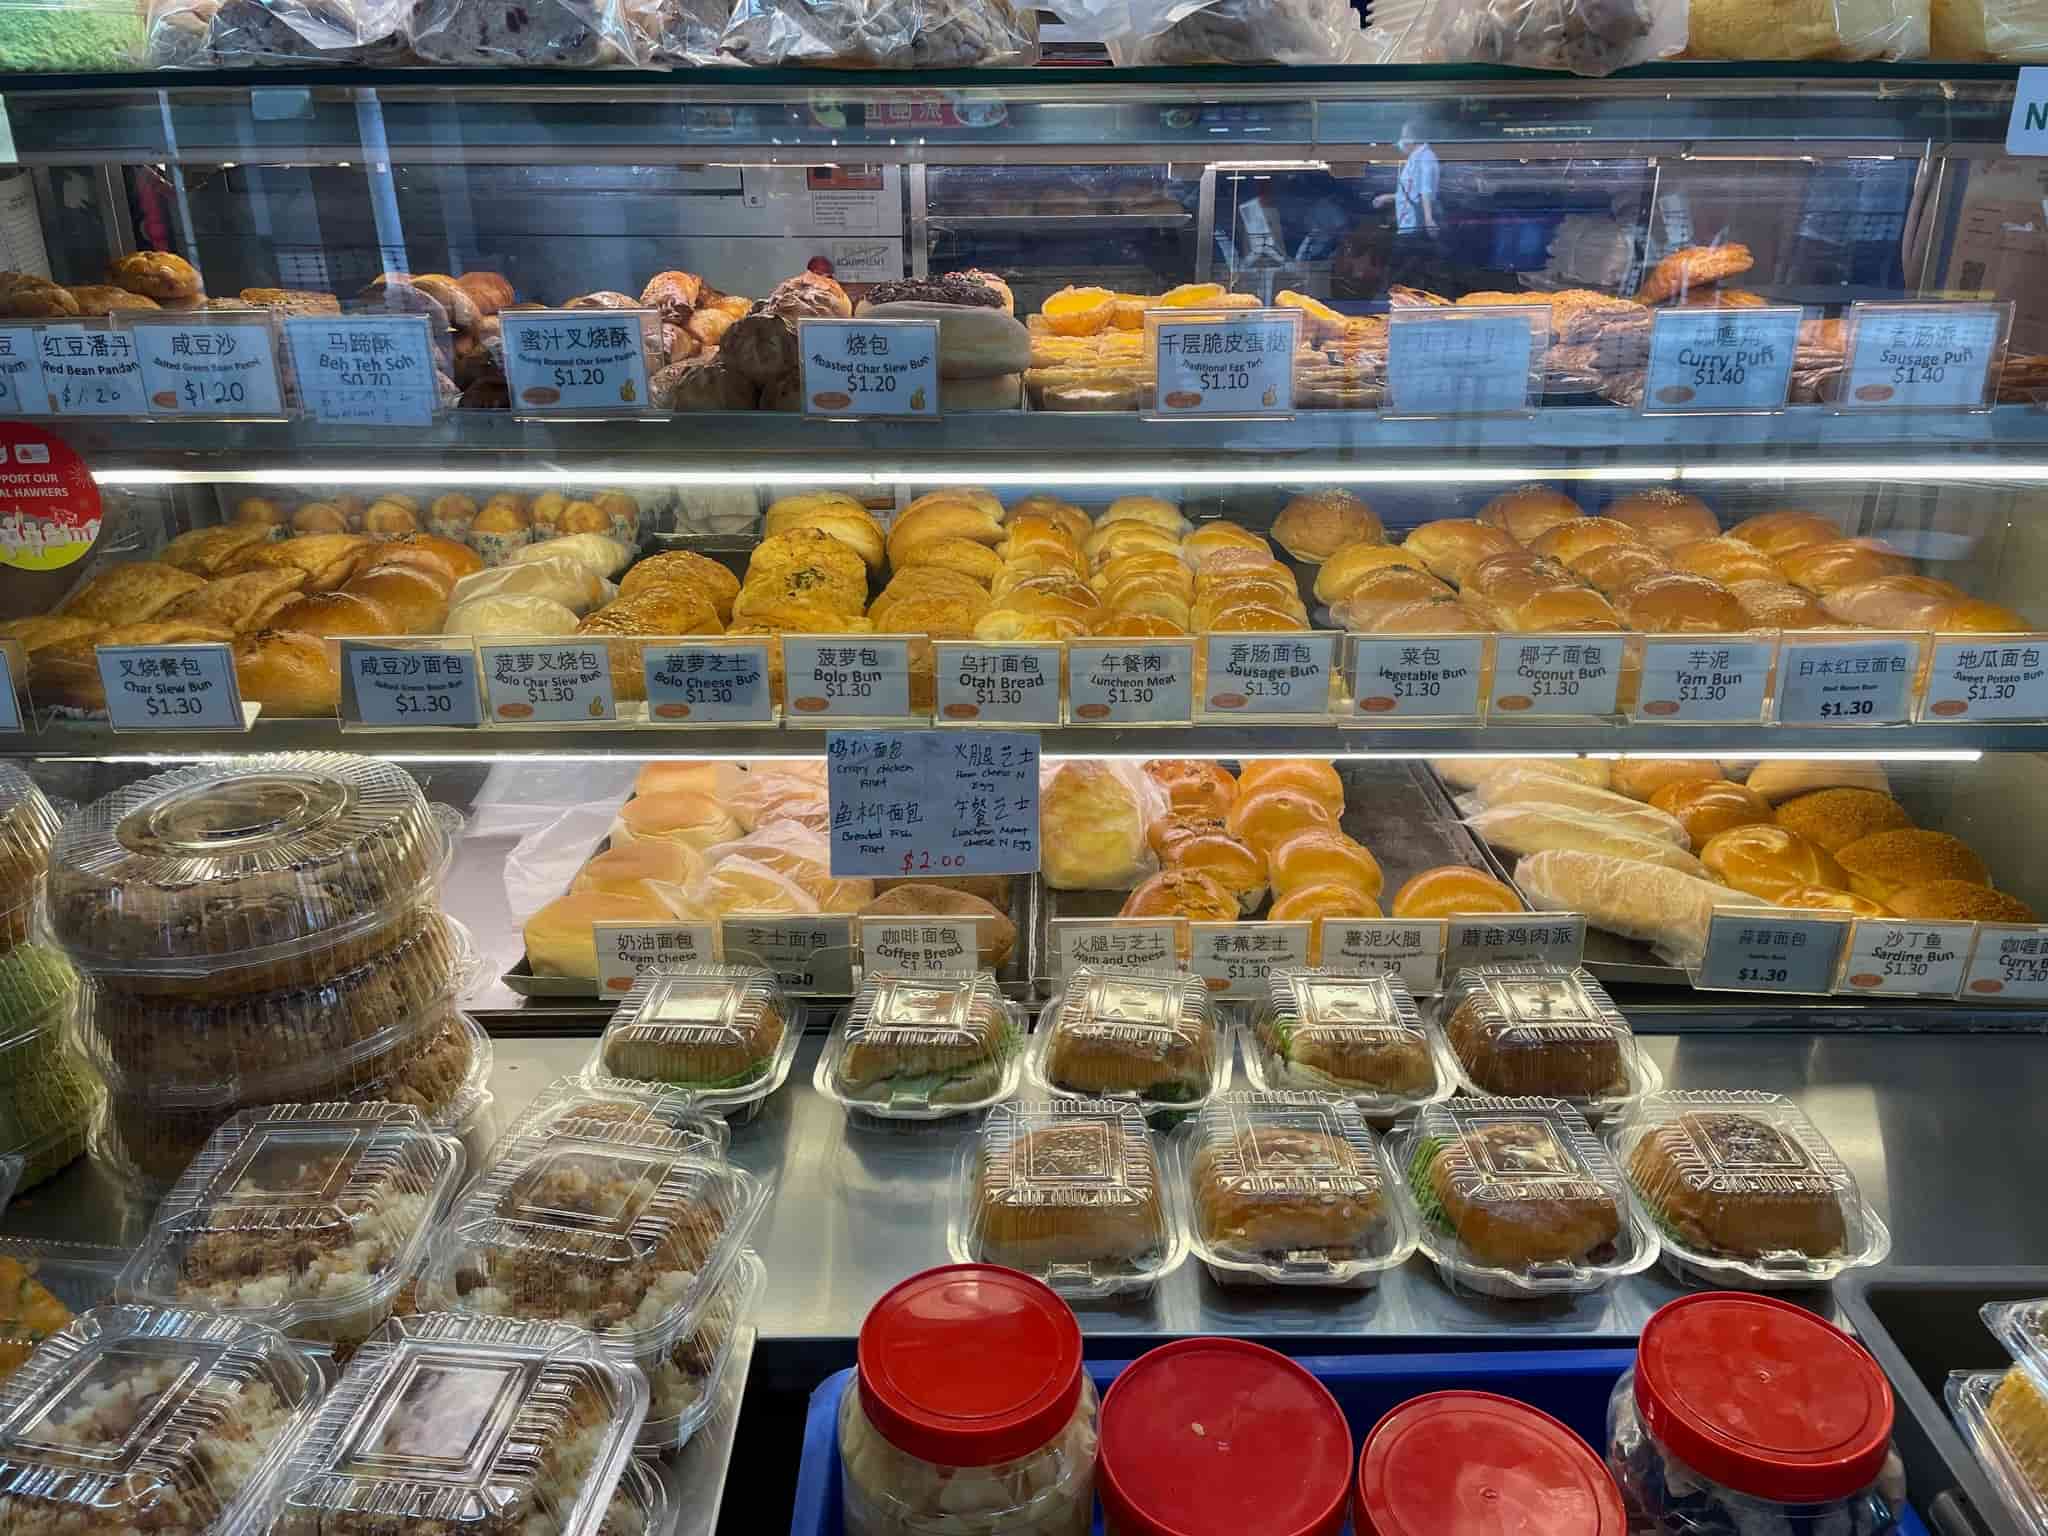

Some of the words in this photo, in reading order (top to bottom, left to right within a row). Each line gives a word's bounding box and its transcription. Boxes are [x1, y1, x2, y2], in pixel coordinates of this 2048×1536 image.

[171, 332, 237, 356] 咸豆沙
[520, 326, 632, 351] 蜜汁叉烧酥
[846, 333, 889, 356] 烧包
[320, 353, 348, 371] Beh
[352, 357, 381, 373] Teh
[385, 354, 416, 371] Soh
[856, 363, 880, 374] Char
[883, 363, 908, 374] Siew
[910, 354, 930, 370] Bun
[1678, 348, 1731, 373] Curry
[1736, 344, 1777, 368] Puff
[1879, 349, 1939, 369] Sausage
[42, 361, 63, 374] Red
[67, 366, 95, 376] Bean
[98, 361, 139, 376] Pandan
[554, 368, 605, 387] $1.20
[1693, 367, 1745, 387] $1.40
[1893, 366, 1945, 385] $1.40
[847, 374, 897, 393] $1.20
[1199, 371, 1250, 392] $1.10
[0, 473, 30, 484] PORT
[15, 486, 70, 498] HAWKERS
[494, 650, 600, 673] 菠萝叉烧包
[664, 653, 749, 673] 菠萝芝士
[817, 647, 879, 667] 菠萝包
[1101, 652, 1161, 673] 午餐肉
[1231, 643, 1312, 664] 香肠面包
[1399, 647, 1441, 666] 菜包
[1520, 645, 1601, 665] 椰子面包
[1688, 650, 1729, 671] 芋泥
[1956, 648, 2041, 670] 地瓜面包
[120, 657, 202, 678] 叉烧餐包
[360, 655, 464, 677] 咸豆沙面包
[960, 654, 1040, 673] 乌打面包
[1225, 661, 1286, 682] Sausage
[1290, 664, 1320, 679] Bun
[1517, 665, 1576, 681] Coconut
[1579, 666, 1607, 680] Bun
[1799, 656, 1906, 677] 日本红豆面包
[551, 677, 578, 688] Siew
[686, 678, 734, 689] Cheese
[735, 671, 761, 686] Bun
[814, 668, 848, 683] Bolo
[853, 671, 882, 683] Bun
[959, 673, 996, 690] Otah
[1000, 673, 1045, 689] Bread
[1090, 674, 1144, 689] Luncheon
[1147, 673, 1177, 687] Meat
[1379, 665, 1439, 683] Vegetable
[1442, 667, 1468, 681] Bun
[1677, 670, 1708, 686] Yam
[1712, 672, 1743, 686] Bun
[528, 687, 574, 704] $1.30
[686, 688, 732, 705] $1.30
[826, 682, 871, 699] $1.30
[976, 688, 1022, 706] $1.30
[1107, 687, 1154, 705] $1.30
[1244, 680, 1291, 697] $1.30
[1393, 681, 1441, 699] $1.30
[1531, 680, 1580, 697] $1.30
[1679, 685, 1727, 703] $1.30
[1967, 683, 2016, 703] $1.30
[146, 696, 202, 717] $1.30
[395, 694, 452, 715] $1.30
[1819, 700, 1874, 719] $1.30
[617, 931, 694, 951] 奶油面包
[745, 927, 827, 949] 芝士面包
[881, 927, 958, 945] 咖啡面包
[1072, 931, 1166, 953] 火腿与芝士
[1214, 934, 1289, 953] 香蕉芝士
[1884, 927, 1942, 950] 沙丁鱼
[617, 951, 655, 964] Cream
[657, 951, 697, 964] Cheese
[876, 944, 921, 961] Coffee
[923, 942, 964, 960] Bread
[1072, 951, 1100, 965] Ham
[1102, 953, 1124, 965] and
[1126, 949, 1168, 964] Cheese
[1872, 946, 1924, 962] Sardine
[1927, 951, 1955, 963] Bun
[1229, 965, 1271, 979] $1.30
[1883, 960, 1929, 976] $1.30
[1999, 954, 2038, 972] Curry
[773, 972, 813, 987] 1.30
[1738, 967, 1788, 982] $1.30
